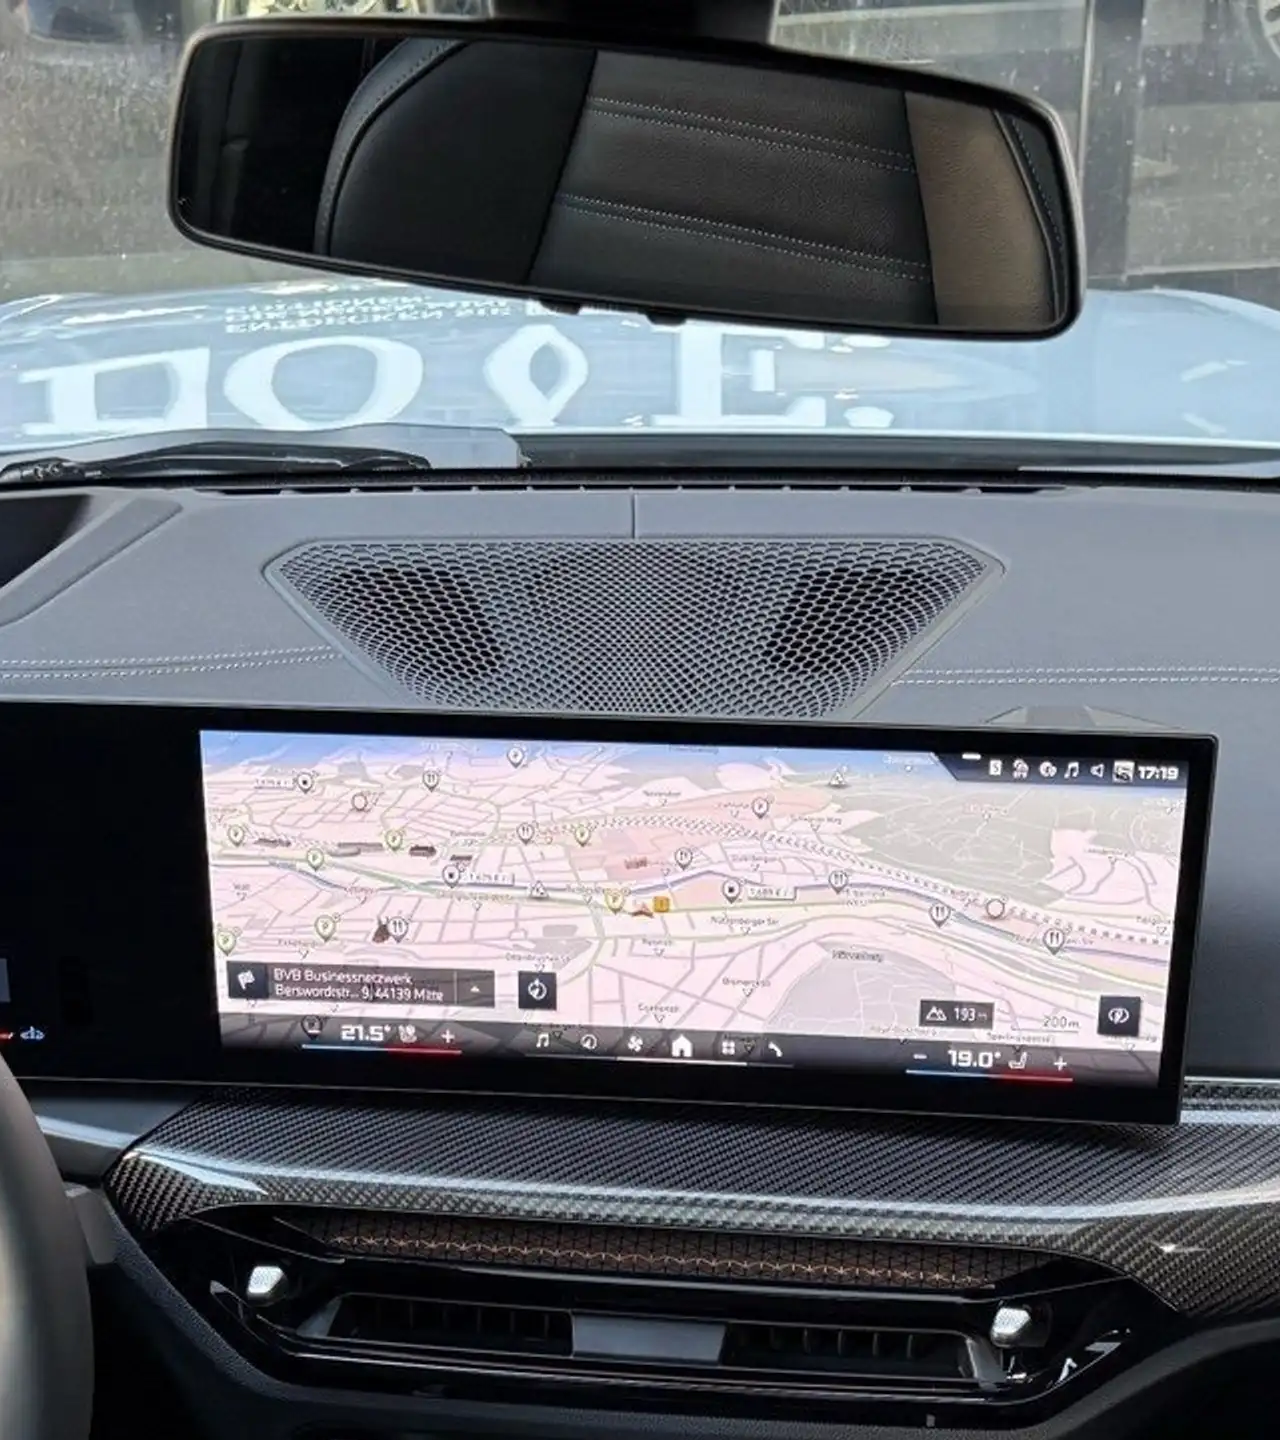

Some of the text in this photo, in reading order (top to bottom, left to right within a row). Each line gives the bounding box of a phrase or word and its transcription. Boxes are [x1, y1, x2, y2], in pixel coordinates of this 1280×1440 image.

[1138, 765, 1179, 780] 17:19
[273, 967, 413, 984] BVB Businessnetzwerk
[413, 987, 444, 1001] Mitte
[954, 1007, 977, 1021] 193
